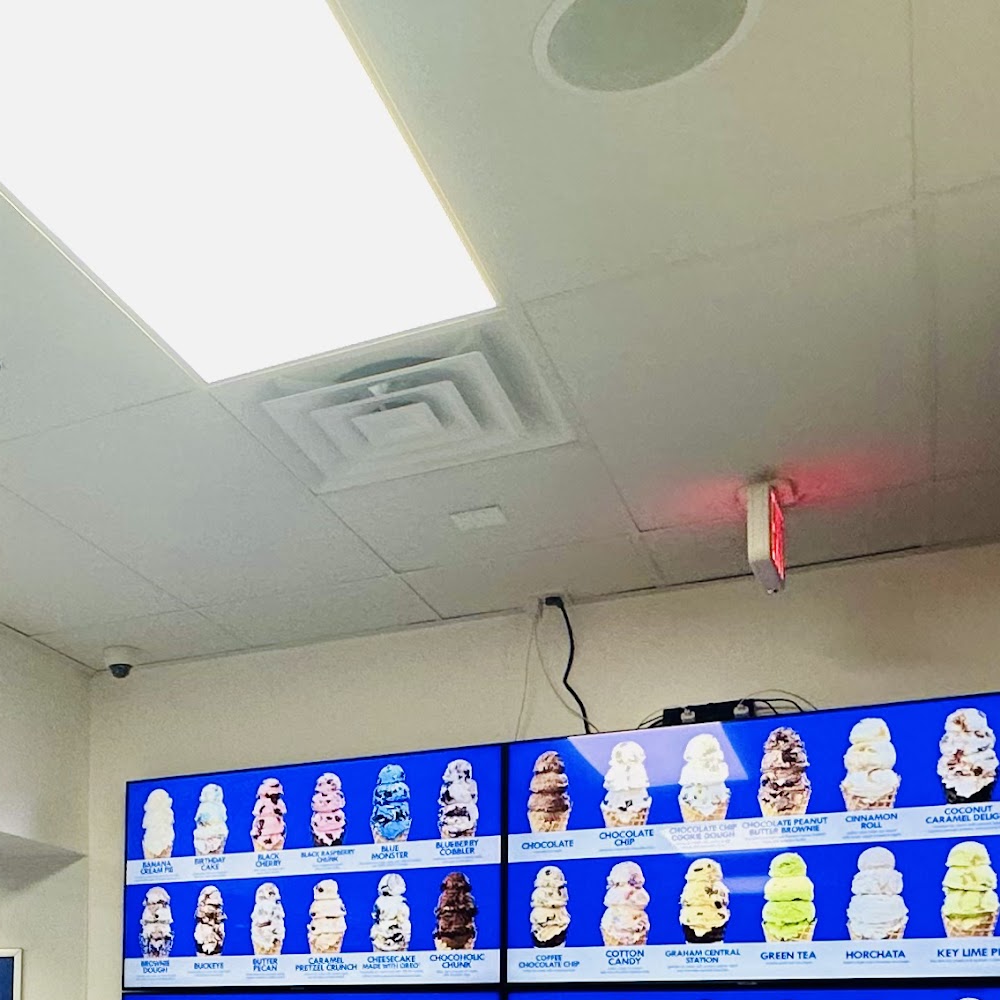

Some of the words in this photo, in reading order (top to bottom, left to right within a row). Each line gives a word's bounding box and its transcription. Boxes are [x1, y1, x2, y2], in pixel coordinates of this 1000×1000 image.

[944, 805, 992, 815] COCONUT
[793, 816, 828, 826] PEANUT
[845, 813, 898, 823] CINNAMON
[925, 814, 971, 824] CARAMEL
[973, 812, 1000, 821] DELIG
[781, 825, 820, 834] BROWNIE
[861, 821, 882, 829] ROLL
[600, 829, 654, 839] CHOCOLATE
[436, 840, 479, 849] BLUEBERRY
[522, 840, 574, 850] CHOCOLATE
[614, 838, 635, 847] CHIP
[258, 852, 279, 860] BLACK
[371, 852, 408, 860] MONSTER
[440, 847, 475, 856] COBBLER
[194, 856, 226, 864] BIRTHDAY
[201, 863, 219, 871] CAKE
[606, 950, 644, 958] COTTON
[760, 951, 794, 960] GREEN
[797, 951, 816, 959] TEA
[846, 950, 906, 959] HORCHATA
[937, 948, 959, 957] KEY
[962, 948, 988, 957] LIME
[991, 948, 1000, 956] PI
[429, 954, 485, 962] CHOCOHOLIC
[536, 954, 562, 962] COFFEE
[608, 957, 641, 966] CANDY
[686, 956, 719, 964] STATION
[194, 962, 224, 970] BUCKEYE
[253, 964, 278, 972] PECAN
[296, 964, 324, 972] PRETZEL
[326, 963, 357, 971] CRUNCH
